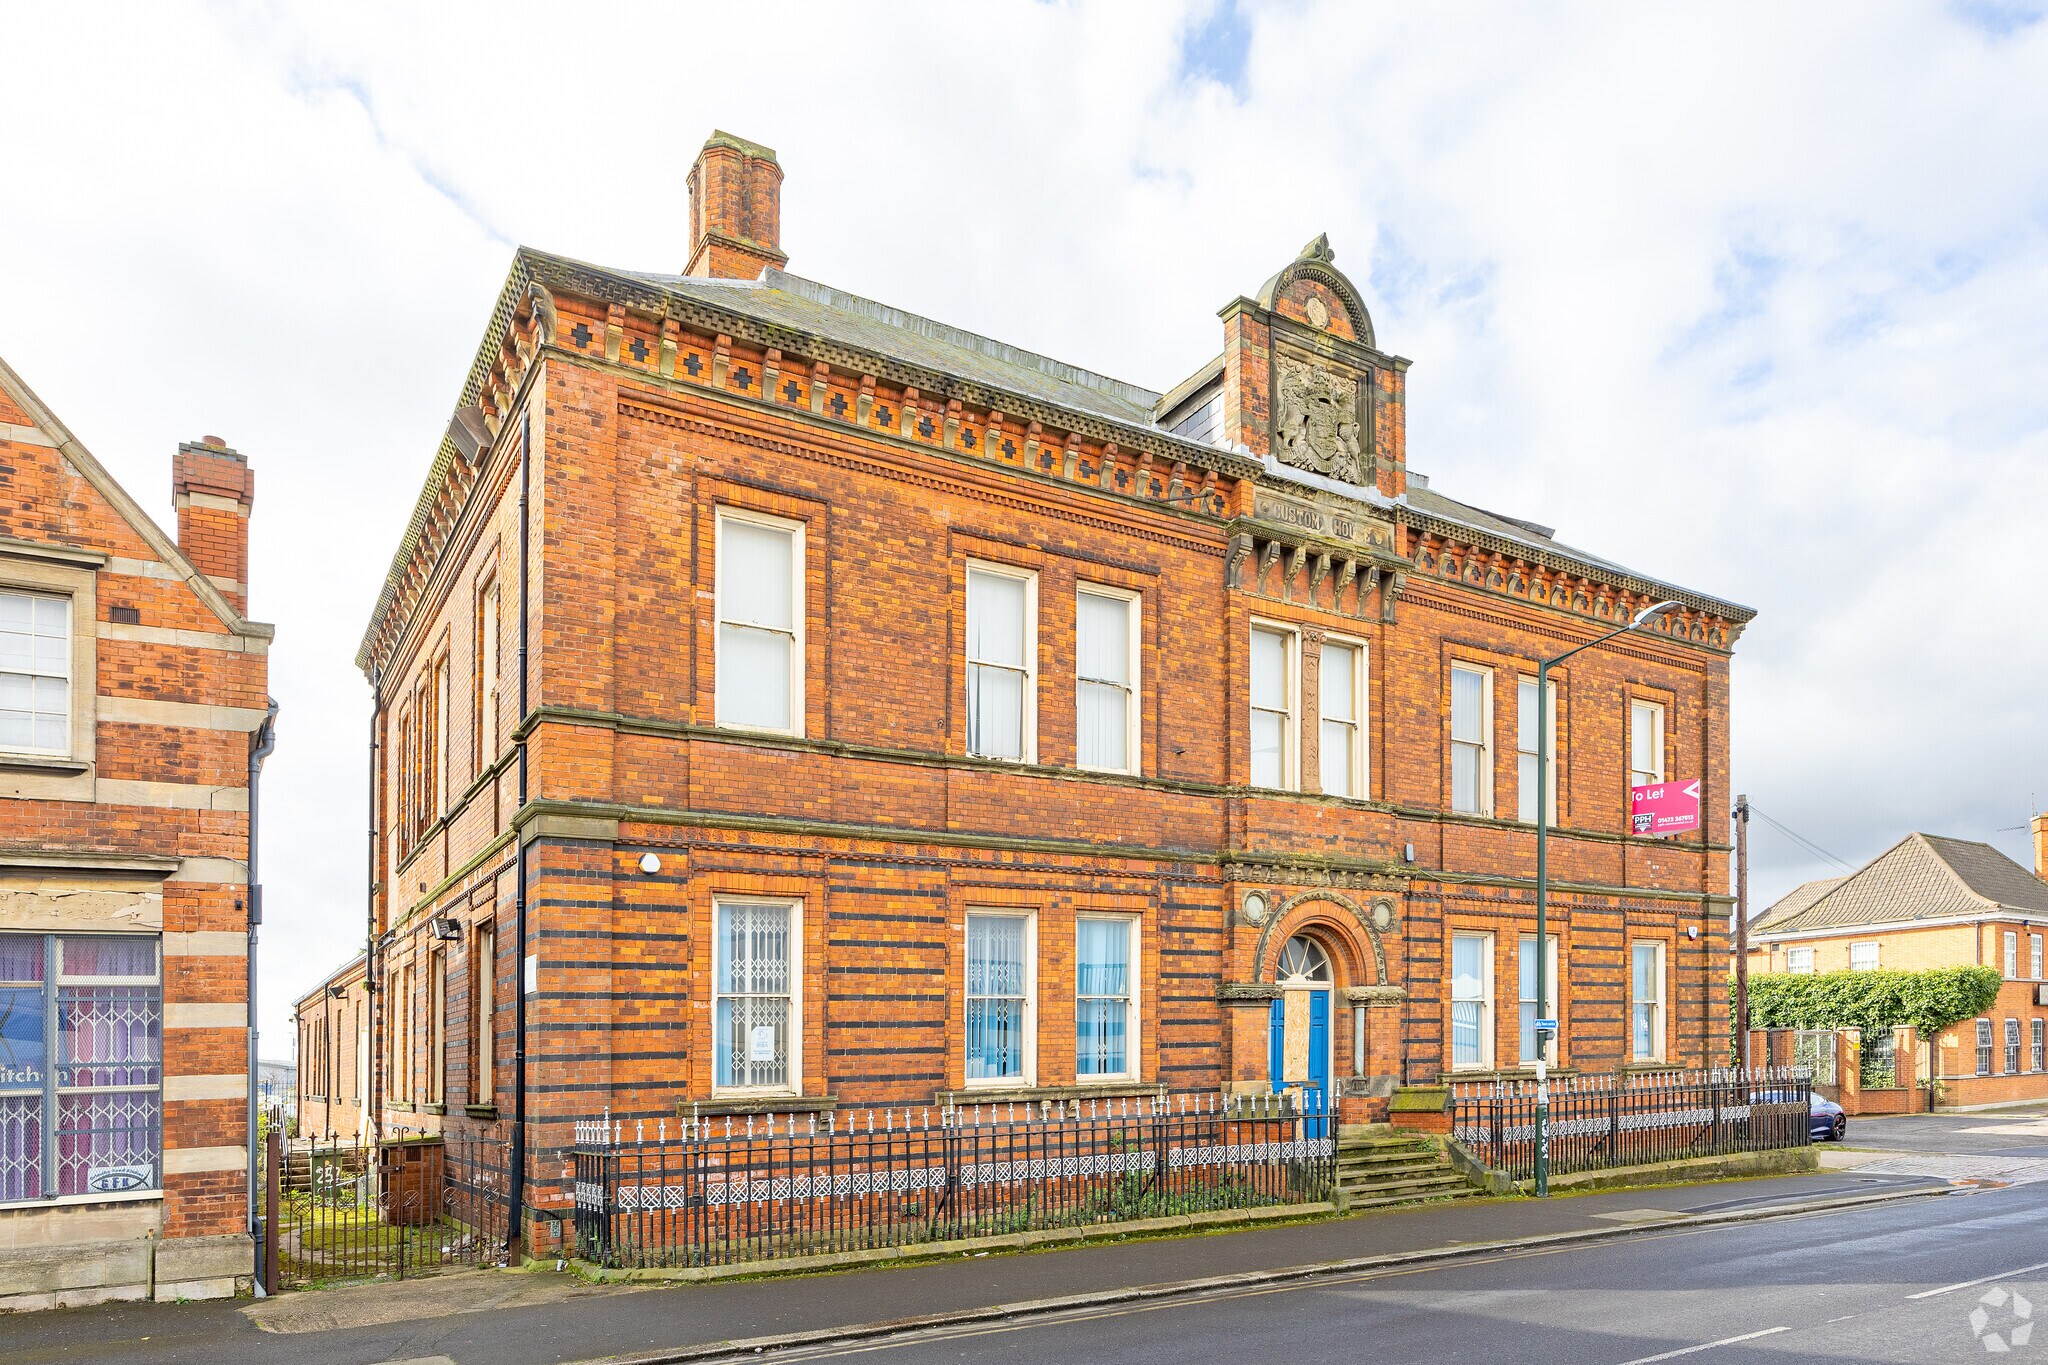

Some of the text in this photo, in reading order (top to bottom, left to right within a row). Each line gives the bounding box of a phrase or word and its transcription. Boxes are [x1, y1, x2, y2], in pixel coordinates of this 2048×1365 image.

[1273, 503, 1321, 530] CUSTOM
[1646, 787, 1665, 800] Let
[1634, 815, 1652, 824] PPH
[0, 1063, 68, 1083] itchn
